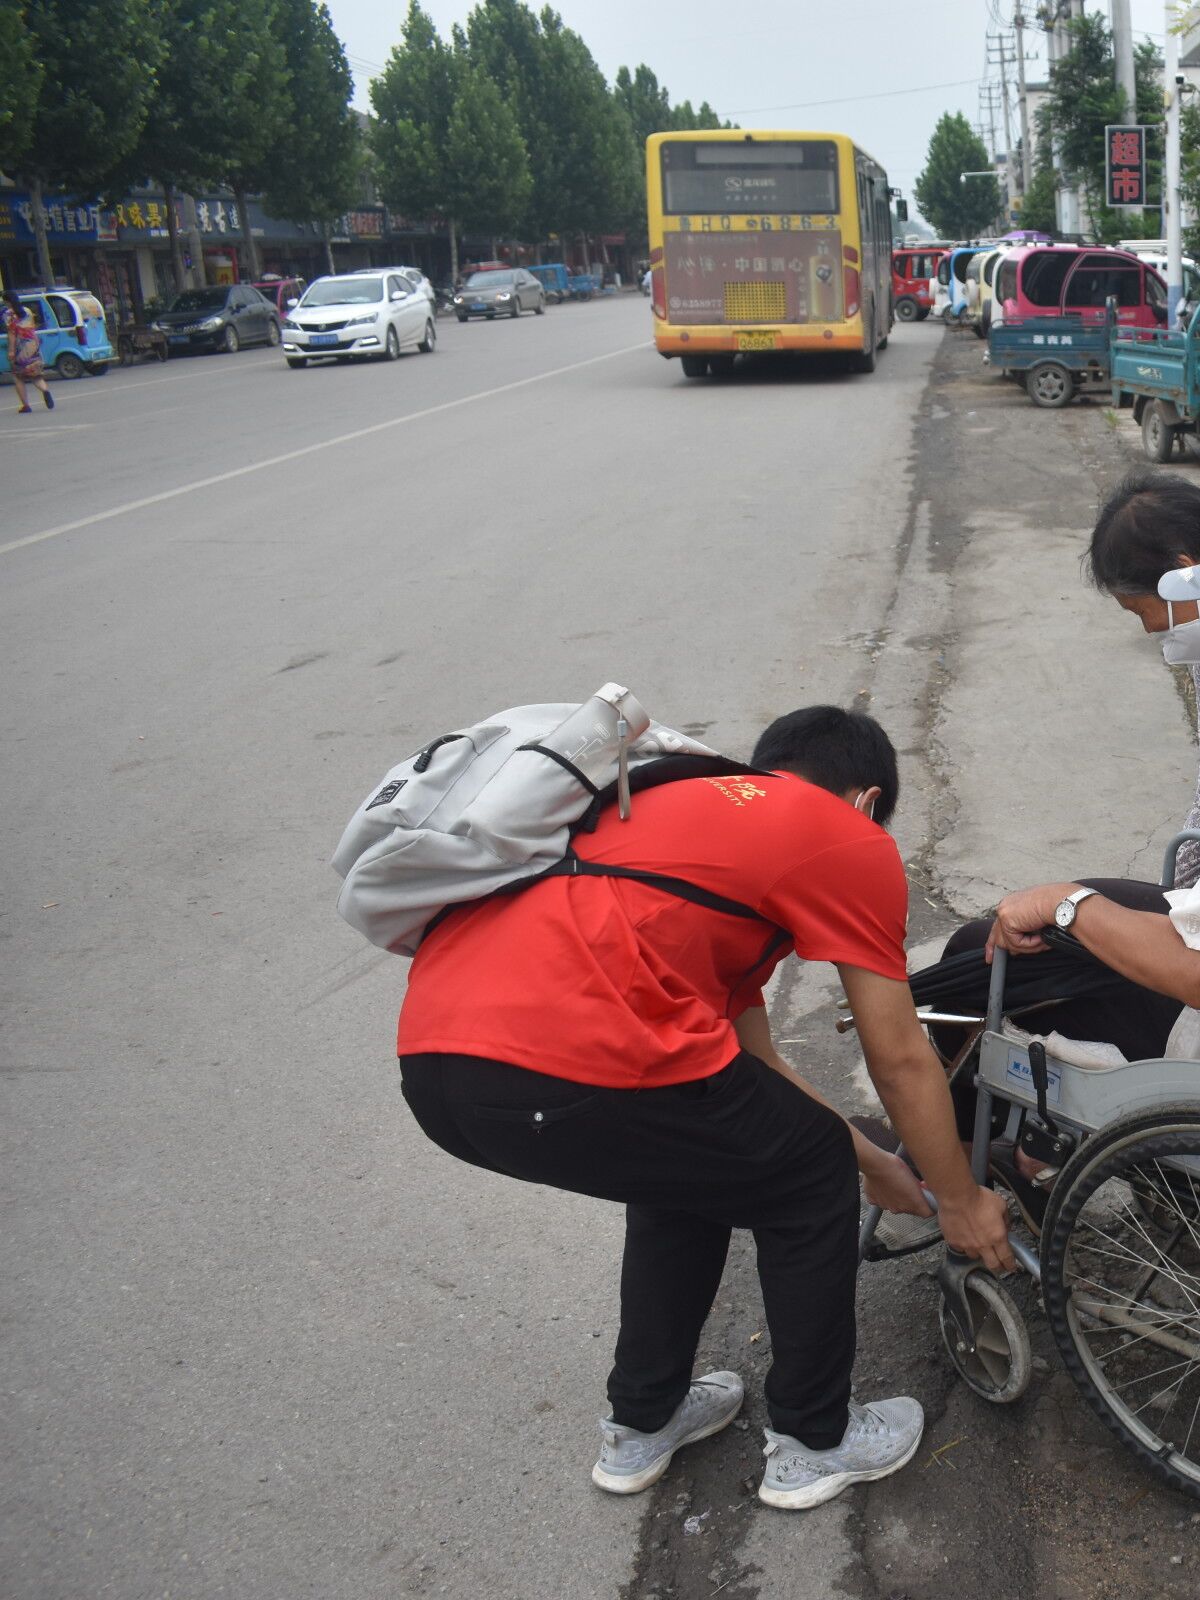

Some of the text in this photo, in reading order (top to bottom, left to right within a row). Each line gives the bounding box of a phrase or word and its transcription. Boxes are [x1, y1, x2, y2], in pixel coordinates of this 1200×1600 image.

[1111, 131, 1140, 203] 超市
[760, 216, 836, 232] 6863
[738, 337, 776, 350] Q6863
